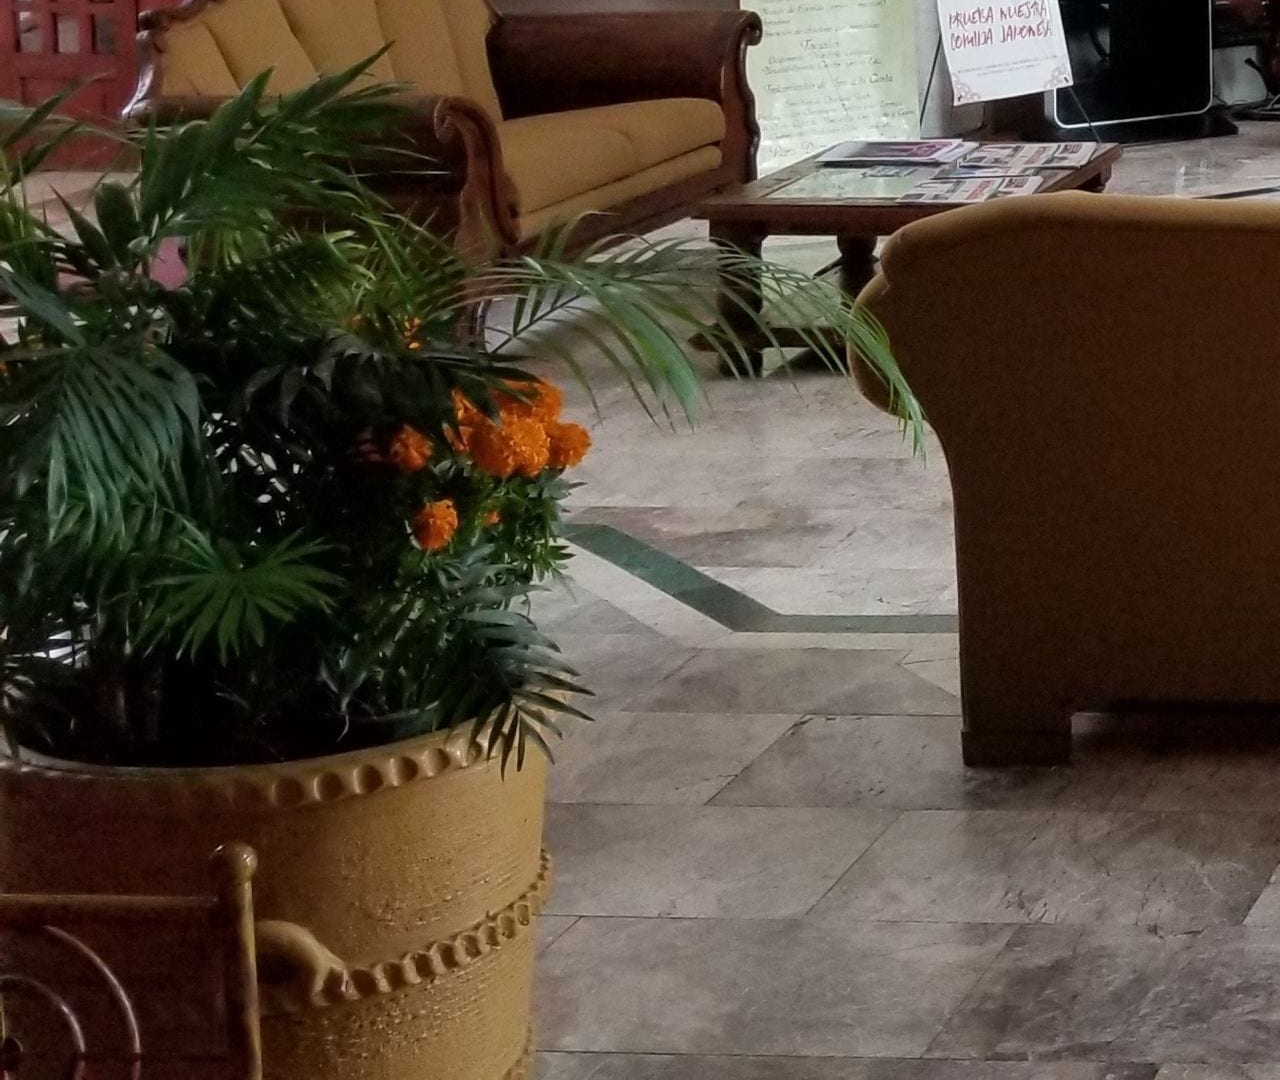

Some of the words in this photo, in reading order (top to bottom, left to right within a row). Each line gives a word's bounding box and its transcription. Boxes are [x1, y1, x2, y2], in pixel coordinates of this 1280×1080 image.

[948, 6, 994, 32] PRUEBA
[1000, 0, 1047, 22] NUESTRA
[950, 28, 994, 51] COMIDA
